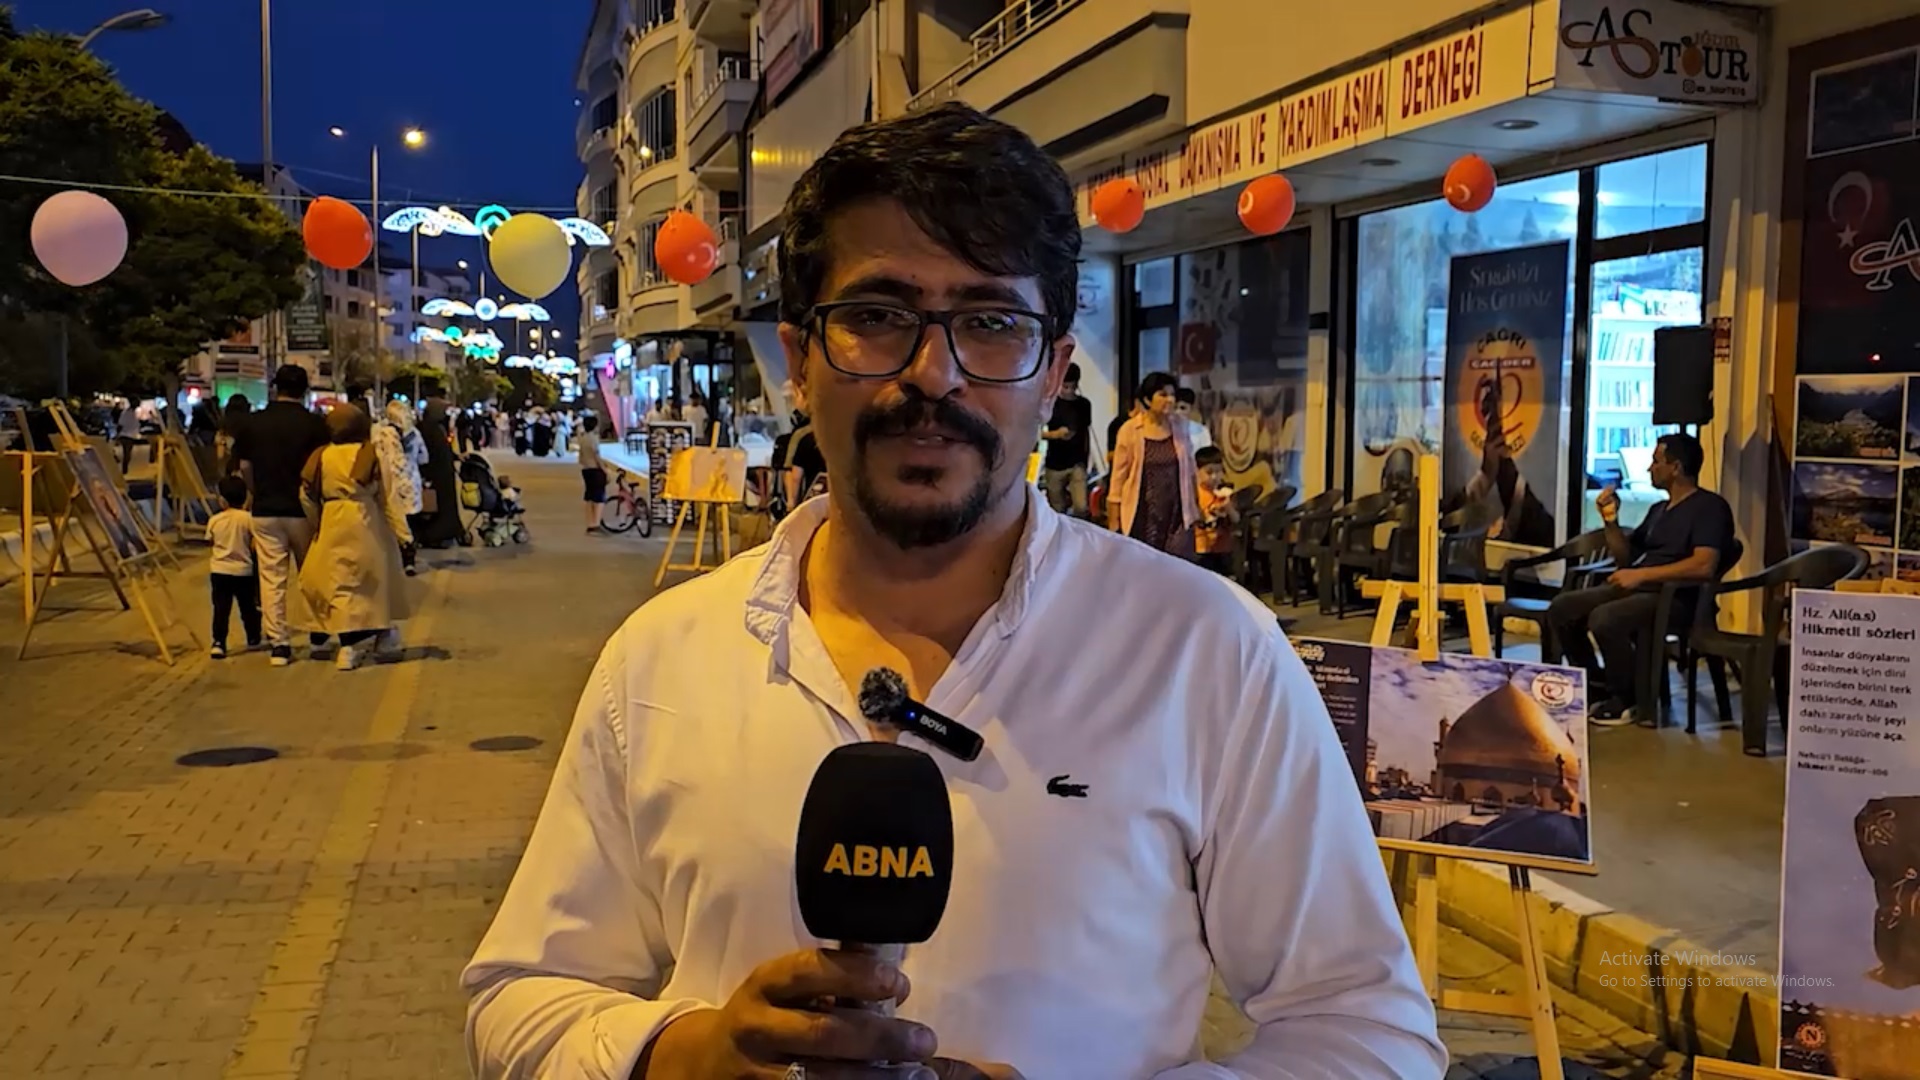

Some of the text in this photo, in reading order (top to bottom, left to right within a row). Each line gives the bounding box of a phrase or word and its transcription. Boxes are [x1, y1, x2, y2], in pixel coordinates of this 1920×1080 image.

[1250, 113, 1266, 167] VE
[1279, 68, 1384, 157] YARDIMLAŞMA
[1401, 18, 1484, 120] DERNEĞİ
[1802, 607, 1823, 619] Hz.
[1802, 623, 1916, 640] Hikmetli sözleri
[1847, 651, 1910, 663] dünyalarını
[1801, 663, 1906, 678] düzeltmek için dini
[1801, 678, 1912, 695] işlerinden birini terk
[1869, 698, 1898, 708] Allah
[919, 714, 947, 736] BOYA
[1799, 709, 1826, 718] daha
[1866, 714, 1881, 723] bir
[1884, 717, 1906, 727] şeyi
[1840, 728, 1881, 738] yüzüne
[823, 843, 935, 878] ABNA
